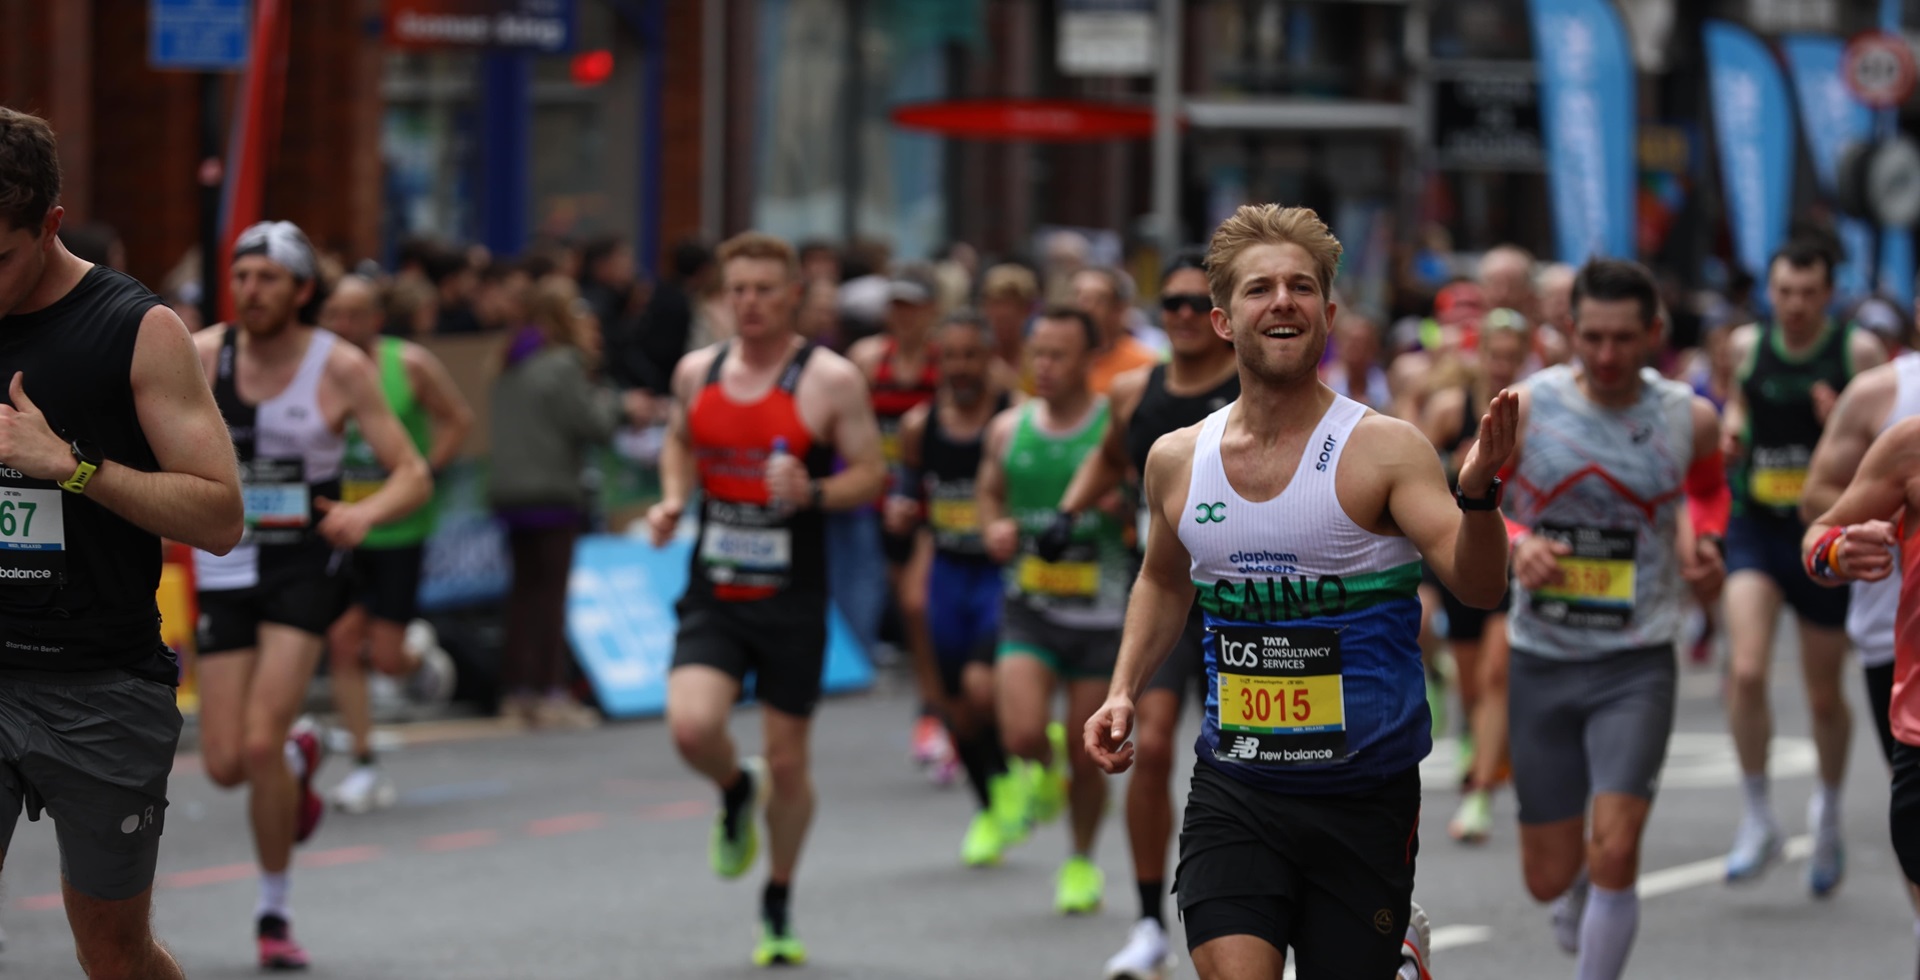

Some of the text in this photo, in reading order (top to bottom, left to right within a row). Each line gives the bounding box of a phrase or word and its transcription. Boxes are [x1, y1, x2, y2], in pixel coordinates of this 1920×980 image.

[1316, 434, 1336, 472] soar
[0, 467, 23, 478] ICES
[0, 500, 37, 537] 67
[1229, 550, 1298, 564] clapham
[0, 567, 51, 579] balance
[6, 641, 31, 651] Started
[1262, 636, 1290, 647] TATA
[1220, 633, 1258, 668] tcs
[1262, 647, 1331, 659] CONSULTANCY
[1262, 659, 1305, 669] SERVICES
[1240, 687, 1311, 722] 3015
[1260, 749, 1333, 761] new balance
